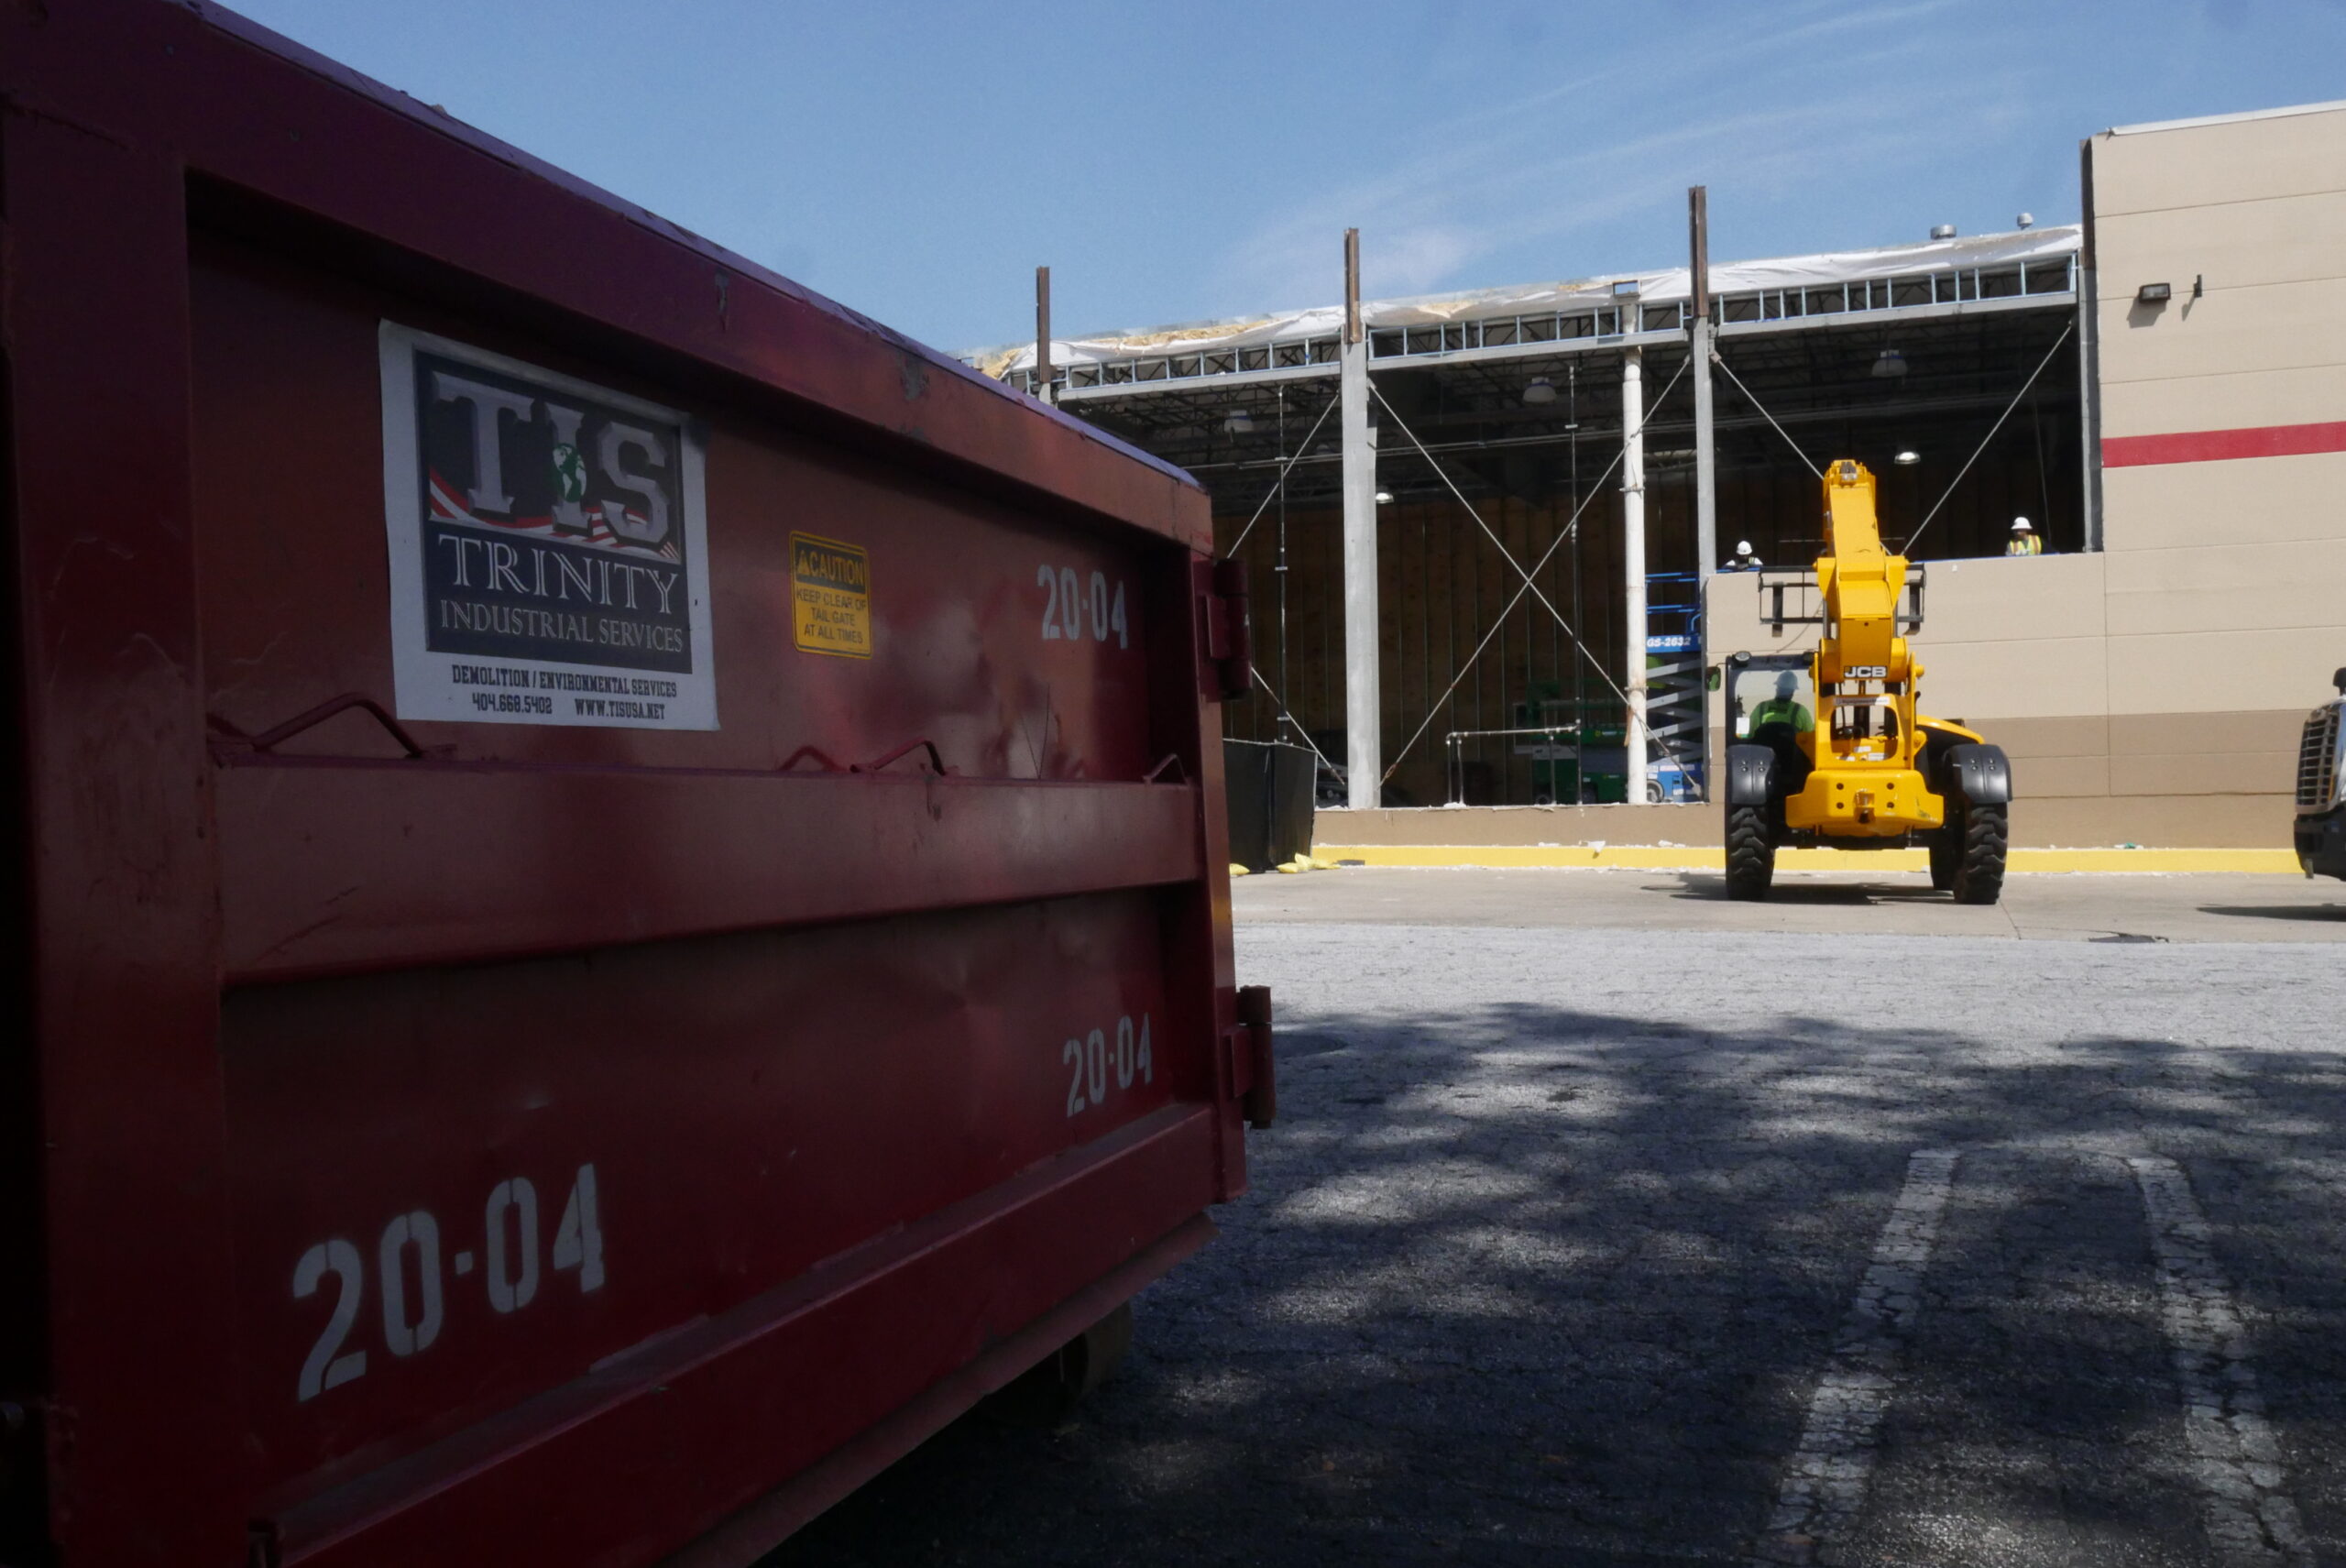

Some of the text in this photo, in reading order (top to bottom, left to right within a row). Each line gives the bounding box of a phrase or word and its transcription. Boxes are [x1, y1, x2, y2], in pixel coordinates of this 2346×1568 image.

[431, 370, 671, 542] TIS
[439, 534, 678, 614] TRINITY
[809, 552, 864, 587] CAUTION
[796, 587, 867, 611] KEEP CLEAR OF
[440, 599, 682, 652] INDUSTRIAL SERVICES
[811, 607, 855, 627] TAIL GATE
[805, 623, 863, 644] AT ALL TIMES
[452, 664, 530, 688] DEMOLITION
[540, 672, 630, 695] ENVIRONMENTAL
[631, 679, 677, 697] SERVICES
[1844, 666, 1887, 678] JCB
[472, 692, 665, 719] 404.668.5402 WWW.TISUSA.NET
